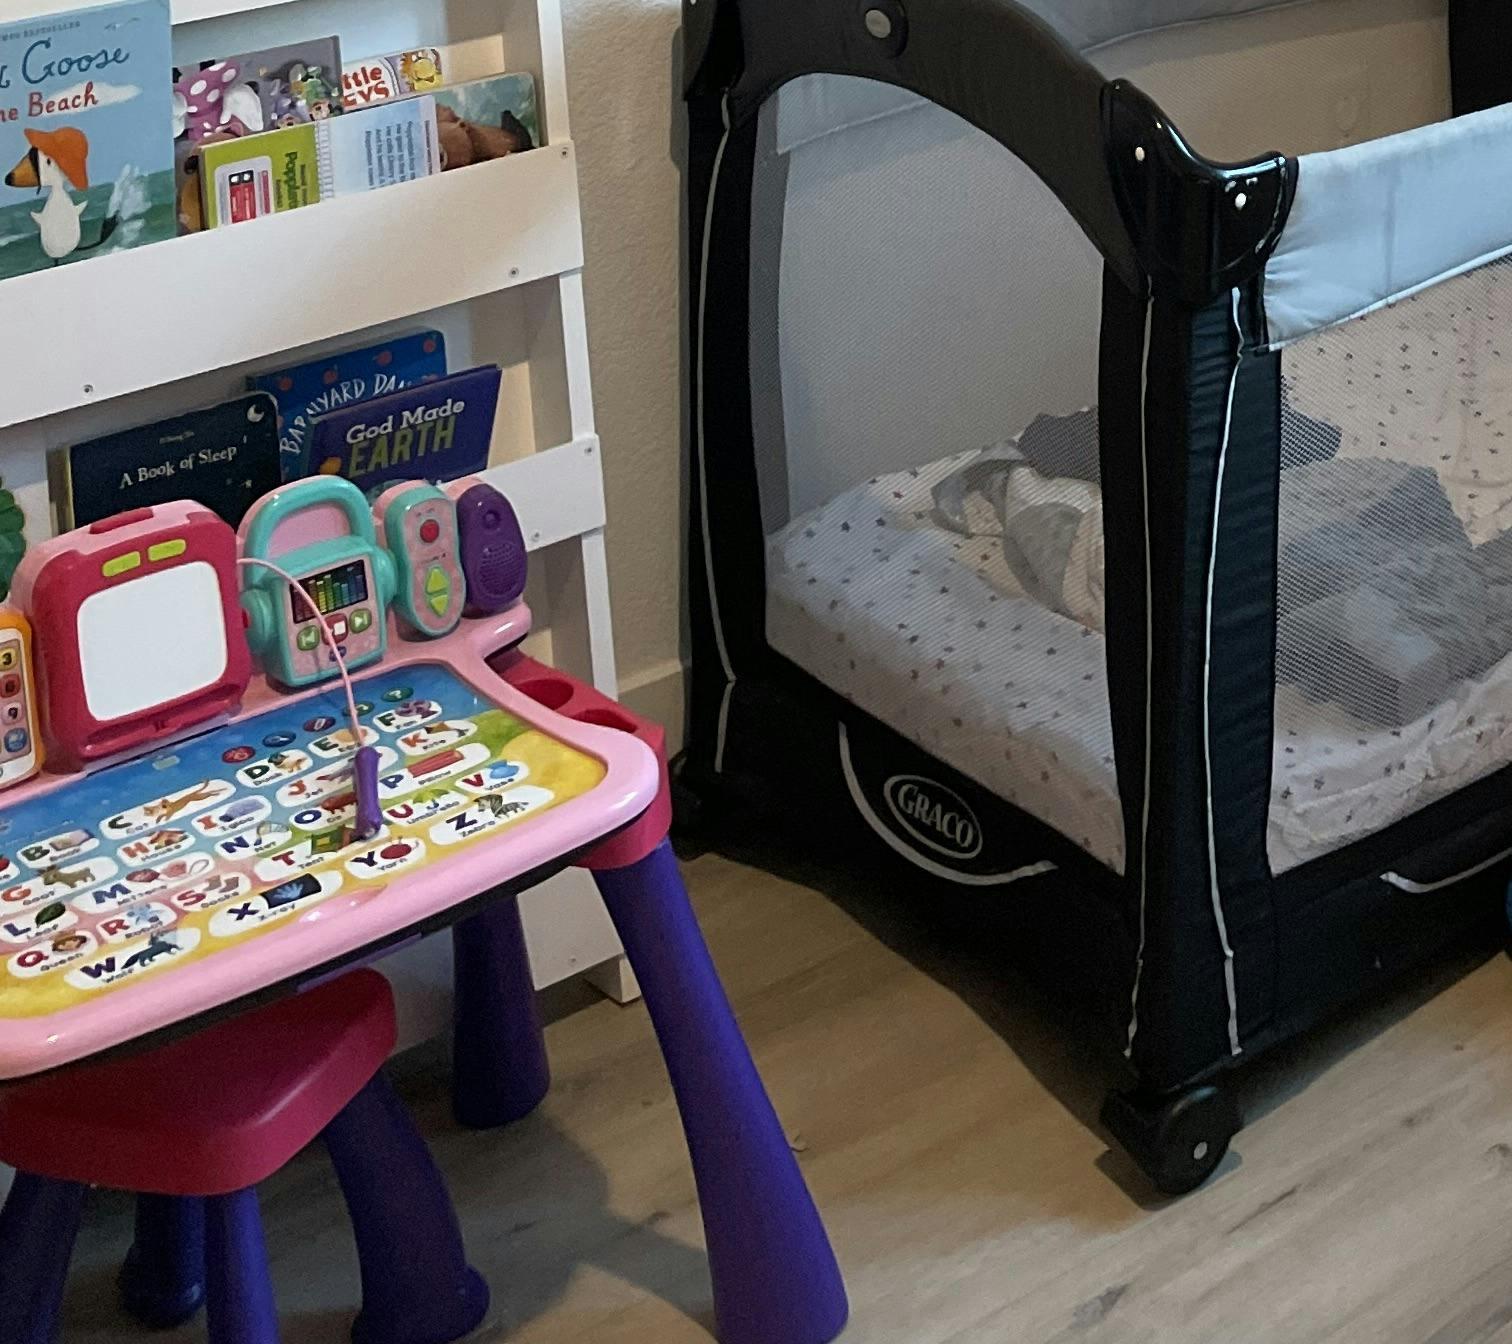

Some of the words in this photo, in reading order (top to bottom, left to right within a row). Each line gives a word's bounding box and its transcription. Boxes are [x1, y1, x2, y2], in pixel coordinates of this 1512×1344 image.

[21, 37, 130, 85] Goose
[27, 80, 99, 118] Beach
[346, 415, 394, 445] God
[401, 398, 465, 429] Made
[349, 414, 457, 479] EARTH
[118, 472, 134, 490] A
[137, 461, 176, 482] Book
[179, 453, 196, 470] of
[198, 446, 238, 465] Sleep
[376, 712, 396, 727] F
[313, 737, 339, 751] E
[401, 732, 428, 748] K
[244, 764, 270, 779] D
[462, 773, 484, 787] V
[288, 779, 308, 796] J
[379, 774, 404, 789] P
[294, 809, 323, 825] O
[387, 803, 413, 819] U
[897, 783, 974, 848] GRACO
[108, 815, 133, 829] C
[197, 815, 218, 830] I
[445, 811, 478, 831] Z
[121, 841, 150, 859] H
[220, 835, 250, 853] N
[20, 845, 51, 861] B
[272, 850, 295, 866] T
[350, 850, 378, 867] Y
[1, 885, 32, 902] G
[92, 883, 131, 905] M
[177, 890, 207, 906] S
[227, 902, 260, 921] X
[3, 922, 32, 937] L
[100, 918, 131, 935] R
[17, 950, 50, 968] Q
[80, 956, 116, 978] W
